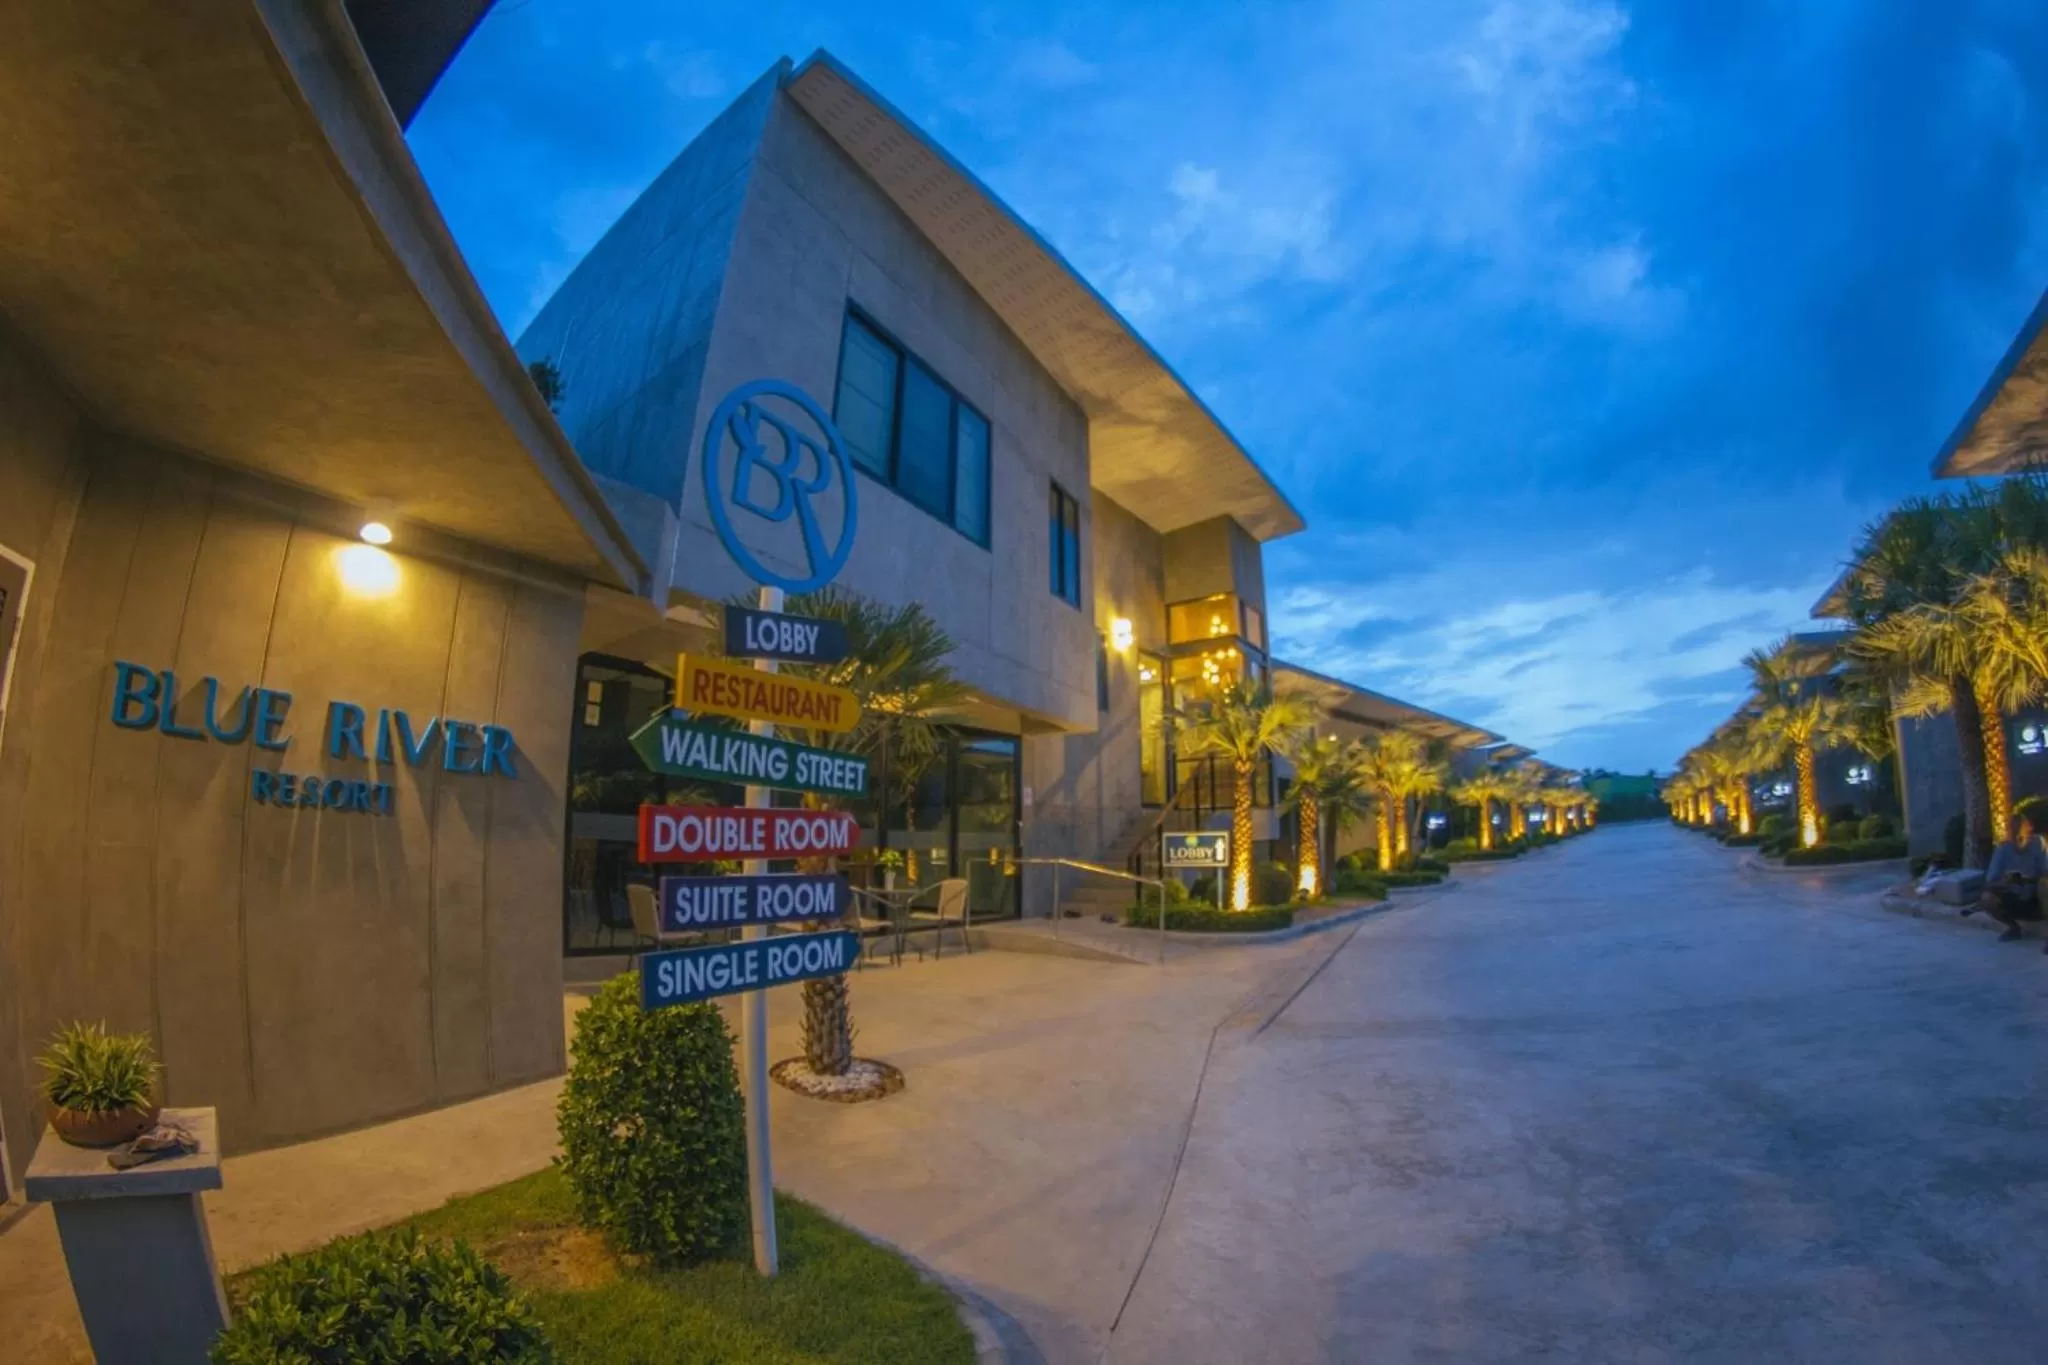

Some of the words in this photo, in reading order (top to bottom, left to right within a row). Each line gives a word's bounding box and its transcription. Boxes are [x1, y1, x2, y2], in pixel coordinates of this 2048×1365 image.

[745, 616, 820, 655] LOBBY
[111, 660, 296, 752] BLUE
[328, 700, 518, 780] RIVER
[692, 668, 842, 725] RESTAURANT
[660, 725, 789, 781] WALKING
[795, 751, 867, 792] STREET
[251, 767, 396, 816] RESORT
[653, 815, 766, 853] DOUBLE
[775, 817, 849, 851] ROOM
[1169, 847, 1214, 859] LOBBY
[675, 885, 748, 924] SUITE
[756, 881, 836, 918] ROOM
[657, 949, 759, 998] SINGLE
[767, 937, 844, 980] ROOM
